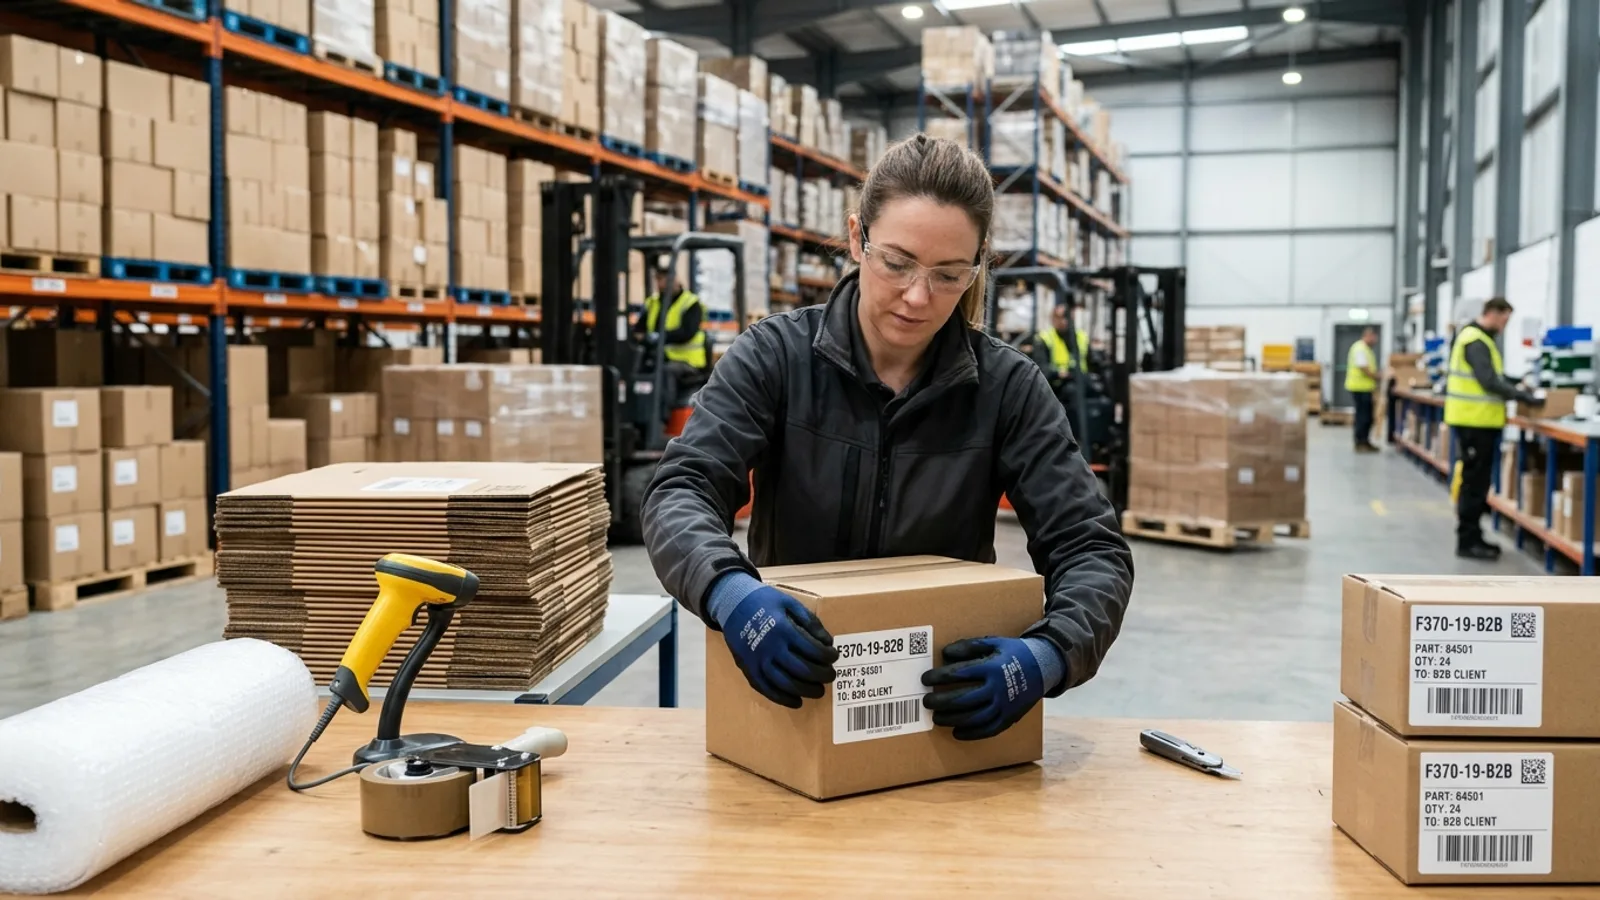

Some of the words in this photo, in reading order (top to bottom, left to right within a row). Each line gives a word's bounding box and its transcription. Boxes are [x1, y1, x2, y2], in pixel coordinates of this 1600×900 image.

[1415, 616, 1503, 632] F370-19-B2B
[1415, 643, 1443, 654] PART:
[1445, 644, 1473, 654] 84501
[1439, 656, 1451, 666] 24
[1414, 669, 1431, 679] TO:
[1454, 669, 1487, 680] CLIENT
[867, 685, 893, 698] CLIENT
[1425, 763, 1513, 779] F370-19-B2B
[1424, 791, 1453, 801] PART:
[1449, 804, 1461, 814] 24
[1424, 816, 1440, 827] TO:
[1463, 816, 1497, 827] CLIENT
